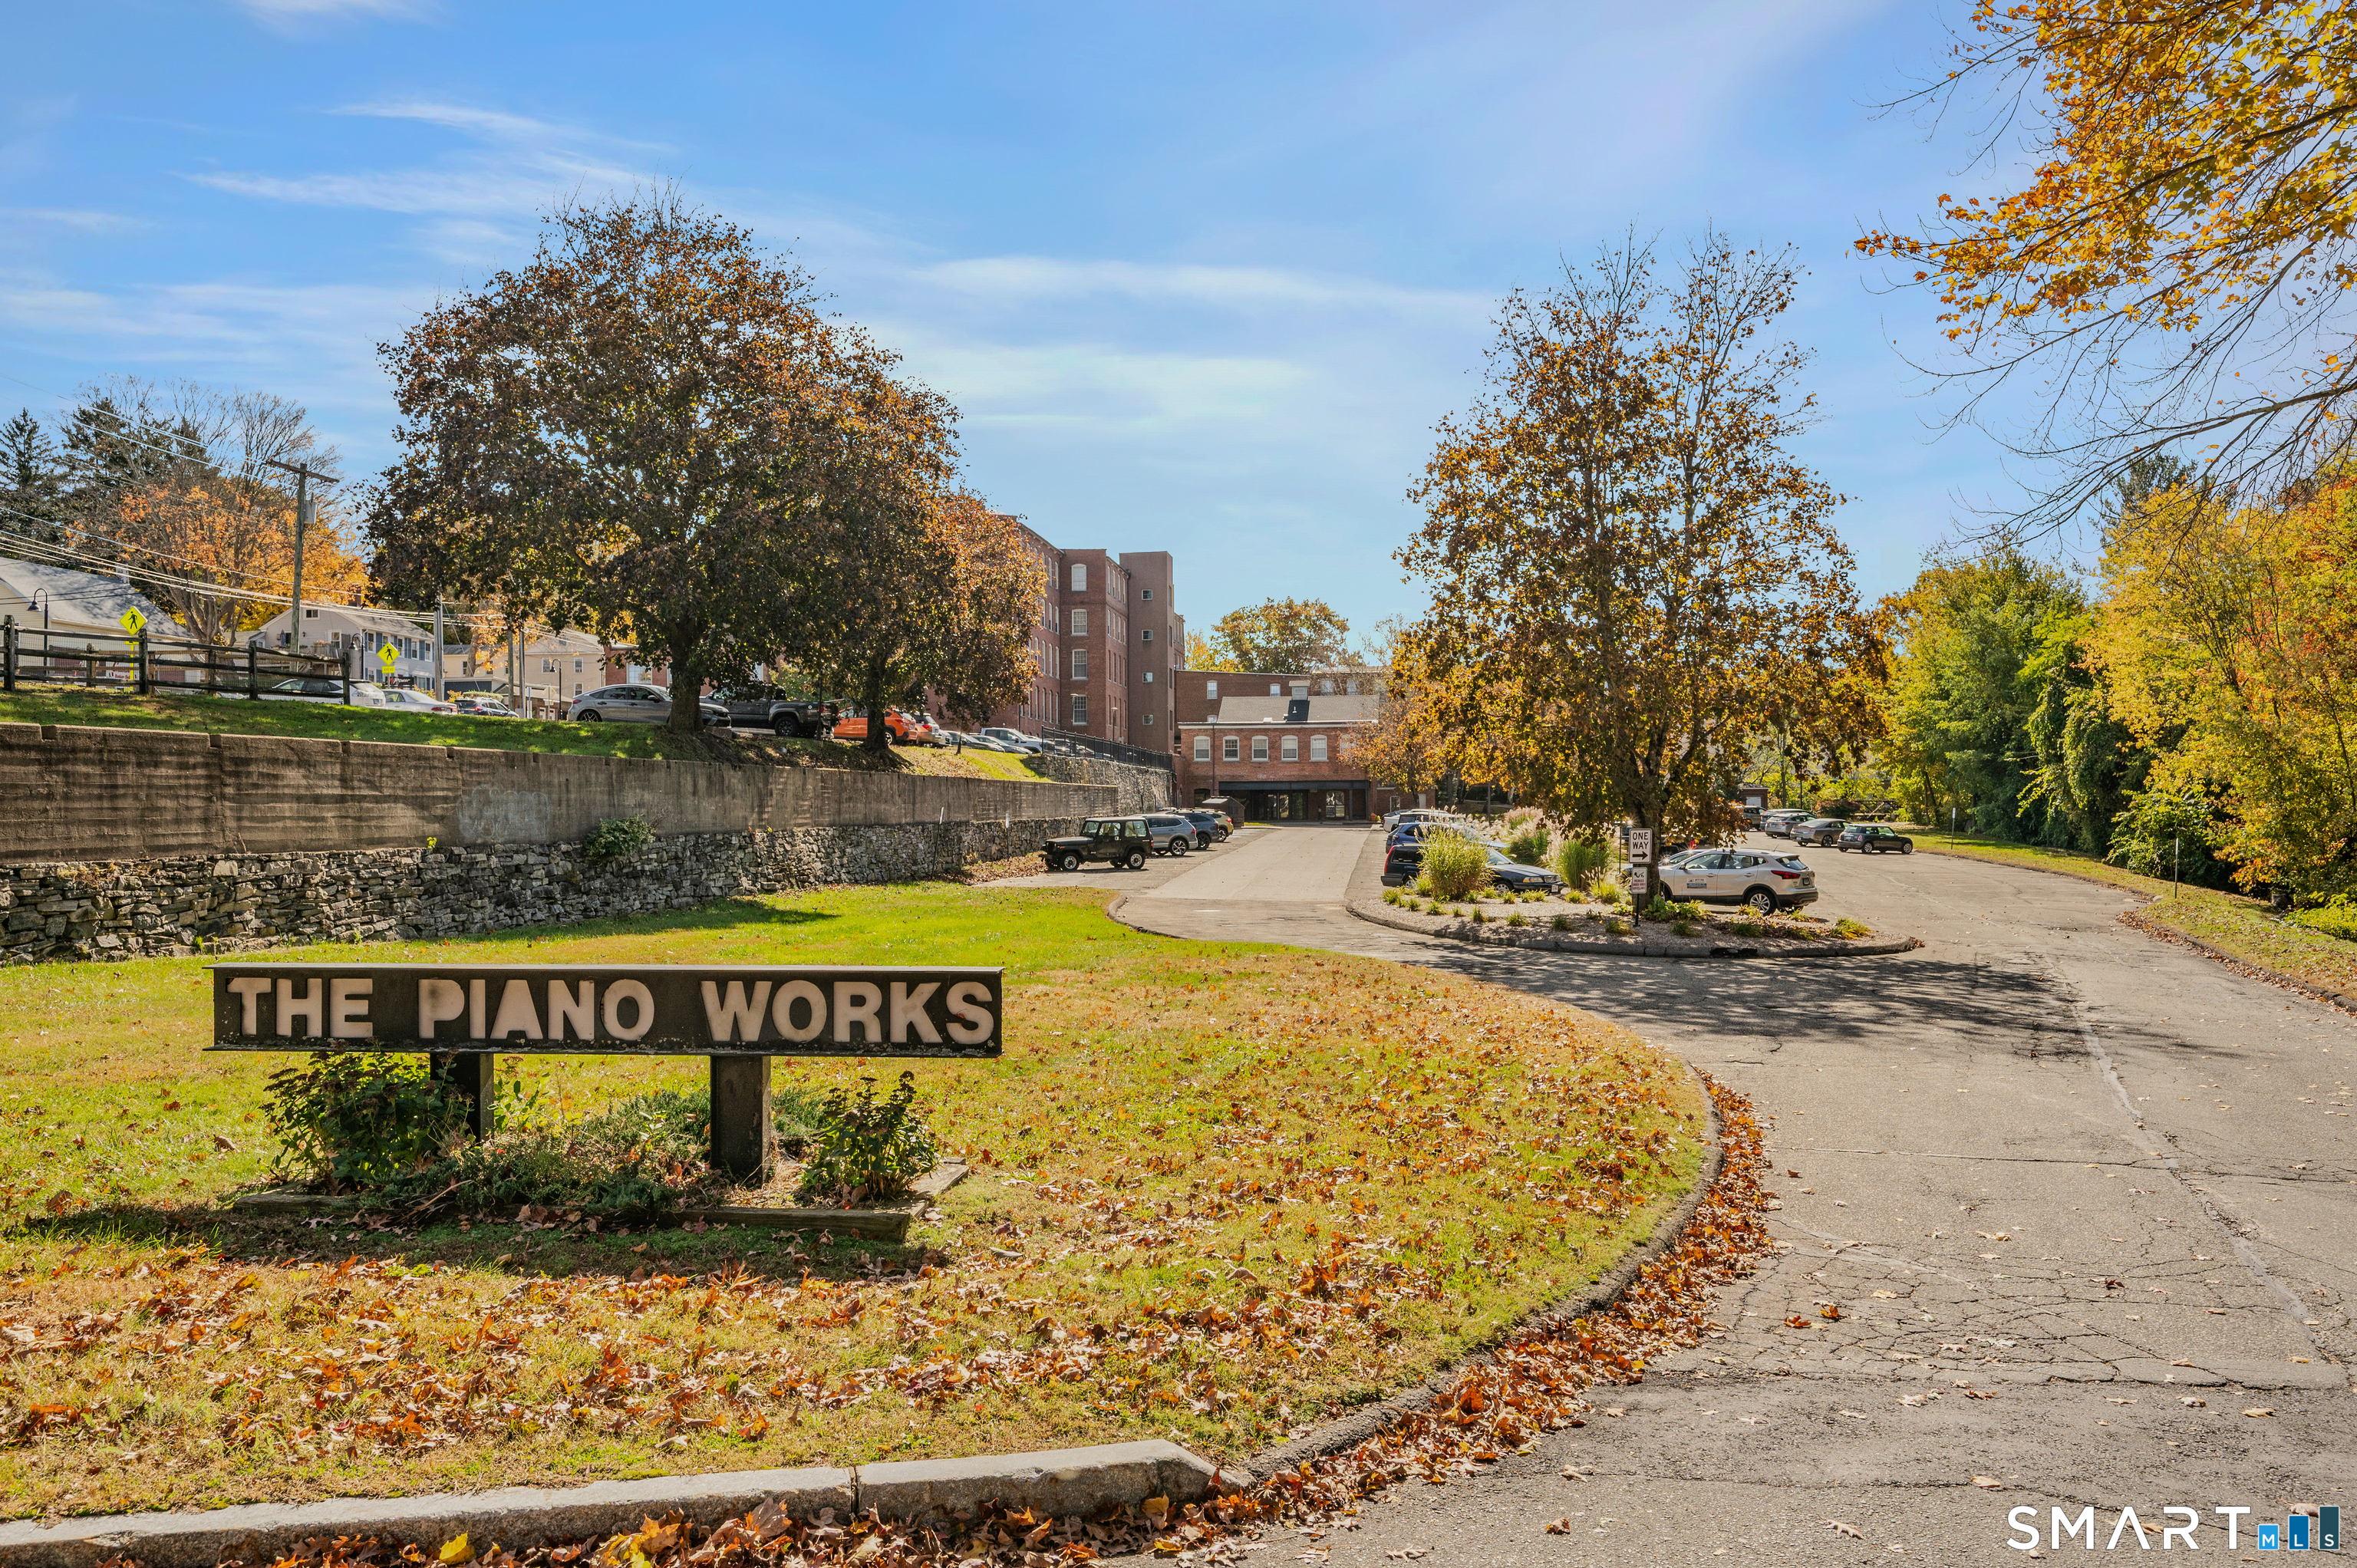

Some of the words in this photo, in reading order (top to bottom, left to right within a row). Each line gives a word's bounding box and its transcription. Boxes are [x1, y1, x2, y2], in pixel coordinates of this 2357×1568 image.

[1632, 832, 1648, 840] ONE
[226, 977, 374, 1039] THE
[418, 978, 654, 1042] PIANO
[699, 979, 994, 1044] WORKS
